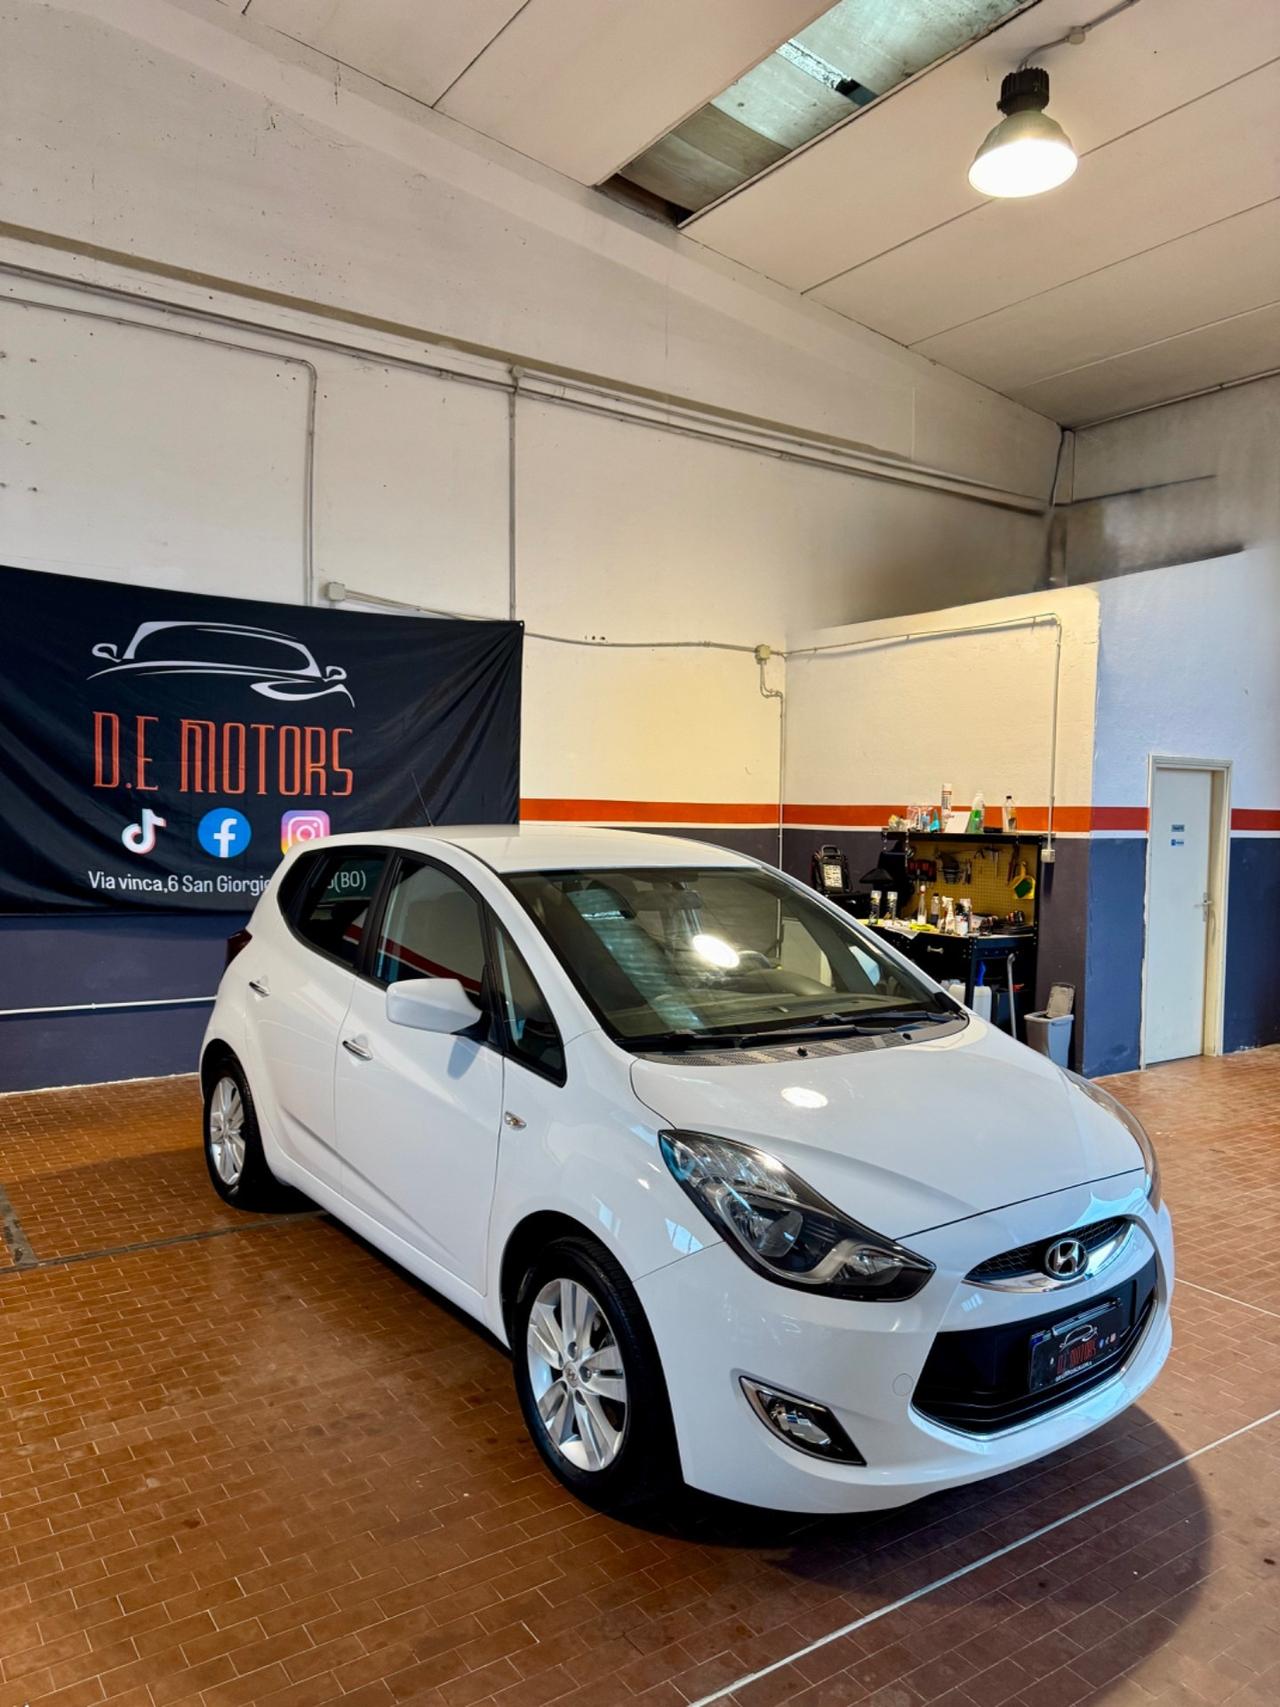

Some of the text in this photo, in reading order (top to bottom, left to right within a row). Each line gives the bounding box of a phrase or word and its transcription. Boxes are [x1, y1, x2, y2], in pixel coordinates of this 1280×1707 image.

[92, 711, 353, 796] D.E MOTORS
[88, 871, 116, 889] Via
[182, 875, 213, 892] San
